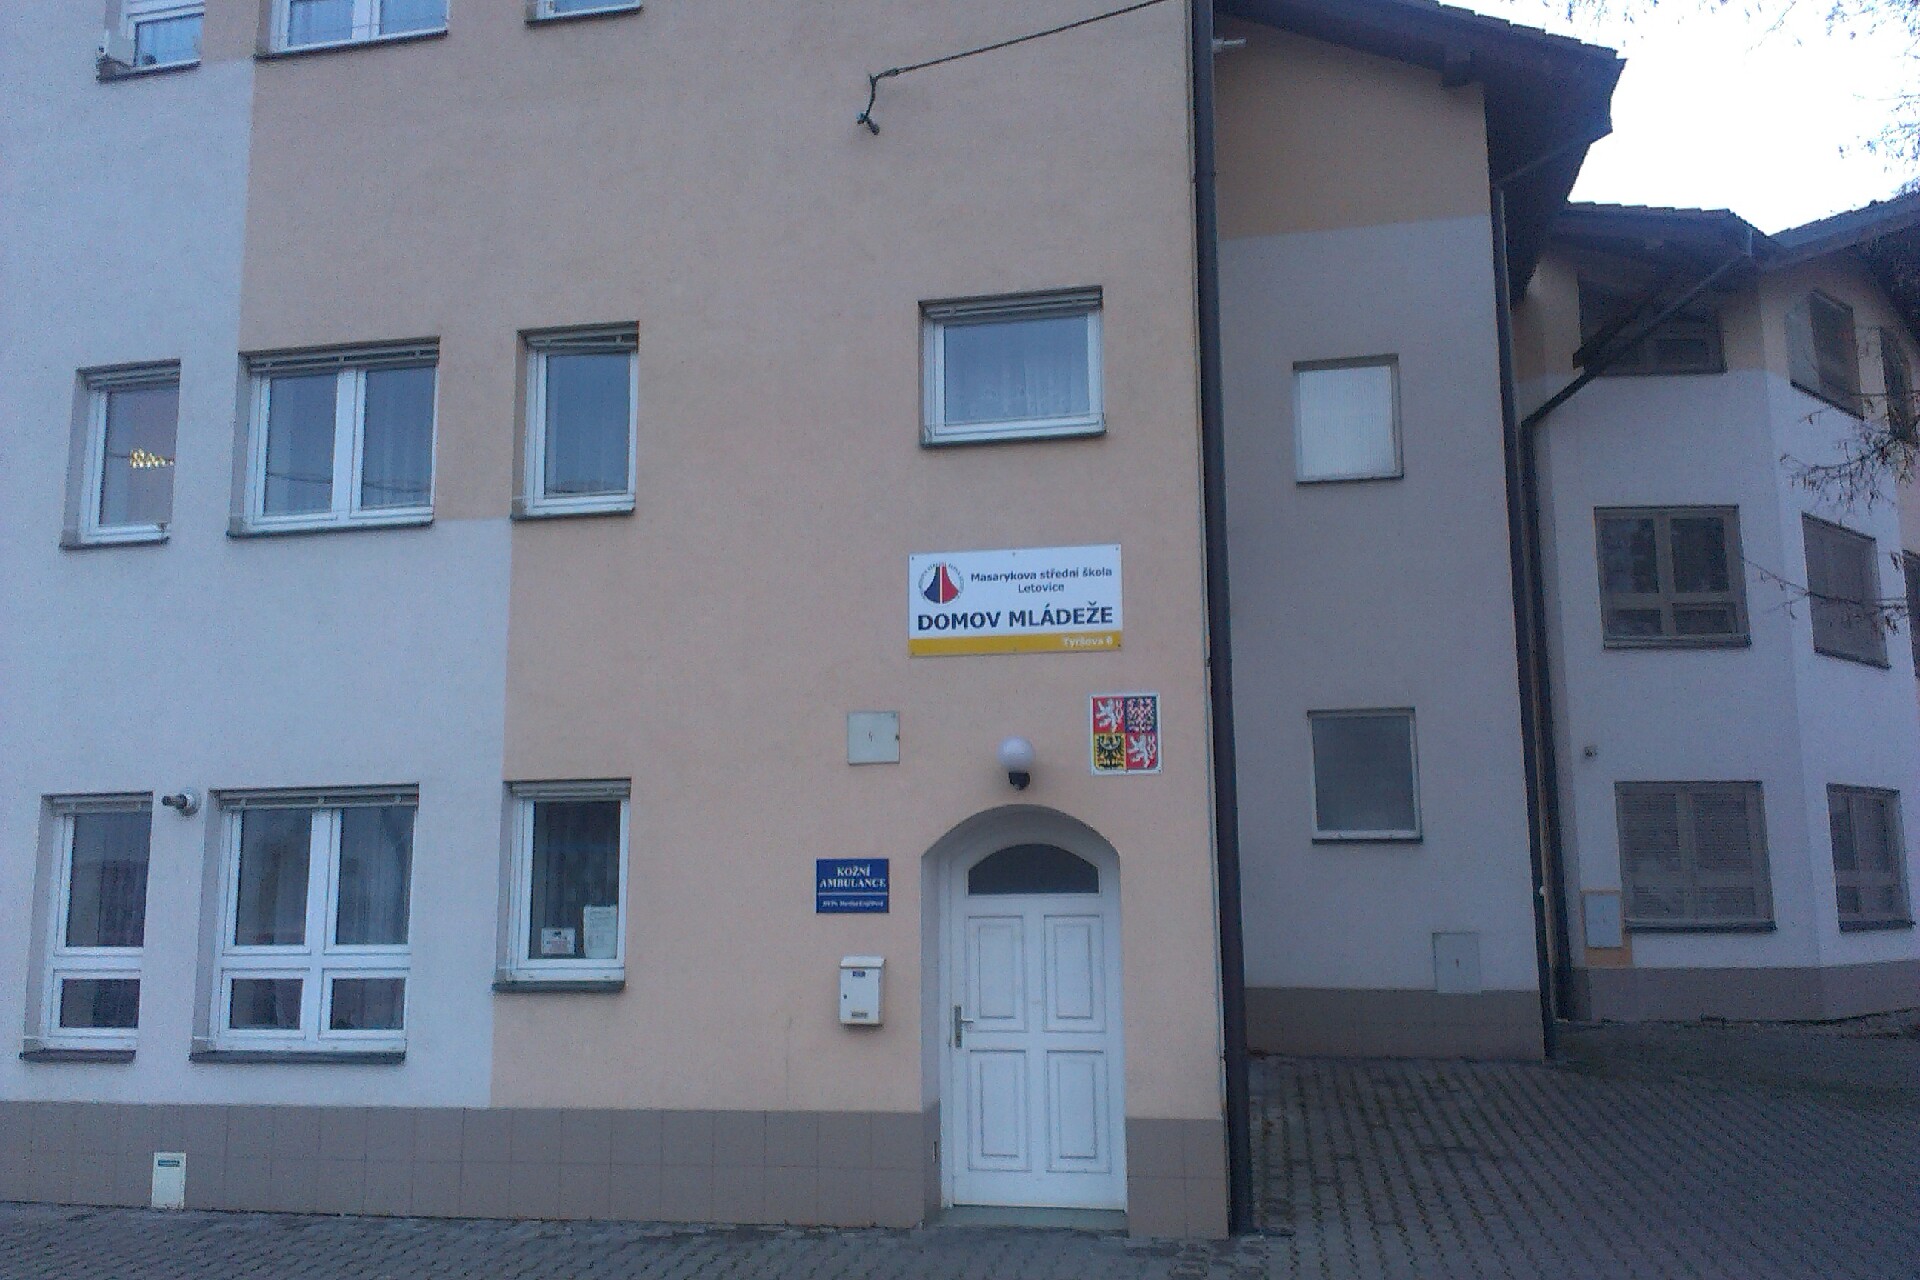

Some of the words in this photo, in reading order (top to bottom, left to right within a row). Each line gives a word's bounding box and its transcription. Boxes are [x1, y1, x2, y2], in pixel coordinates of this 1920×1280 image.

[971, 571, 1037, 583] Masarykova
[1040, 567, 1079, 579] střední
[1082, 566, 1113, 578] škola
[1018, 582, 1065, 594] Letovice
[917, 611, 1001, 631] DOMOV
[1008, 601, 1113, 628] MLÁDEŽE
[836, 863, 871, 877] KOŽNÍ
[819, 878, 887, 888] AMBULANCE
